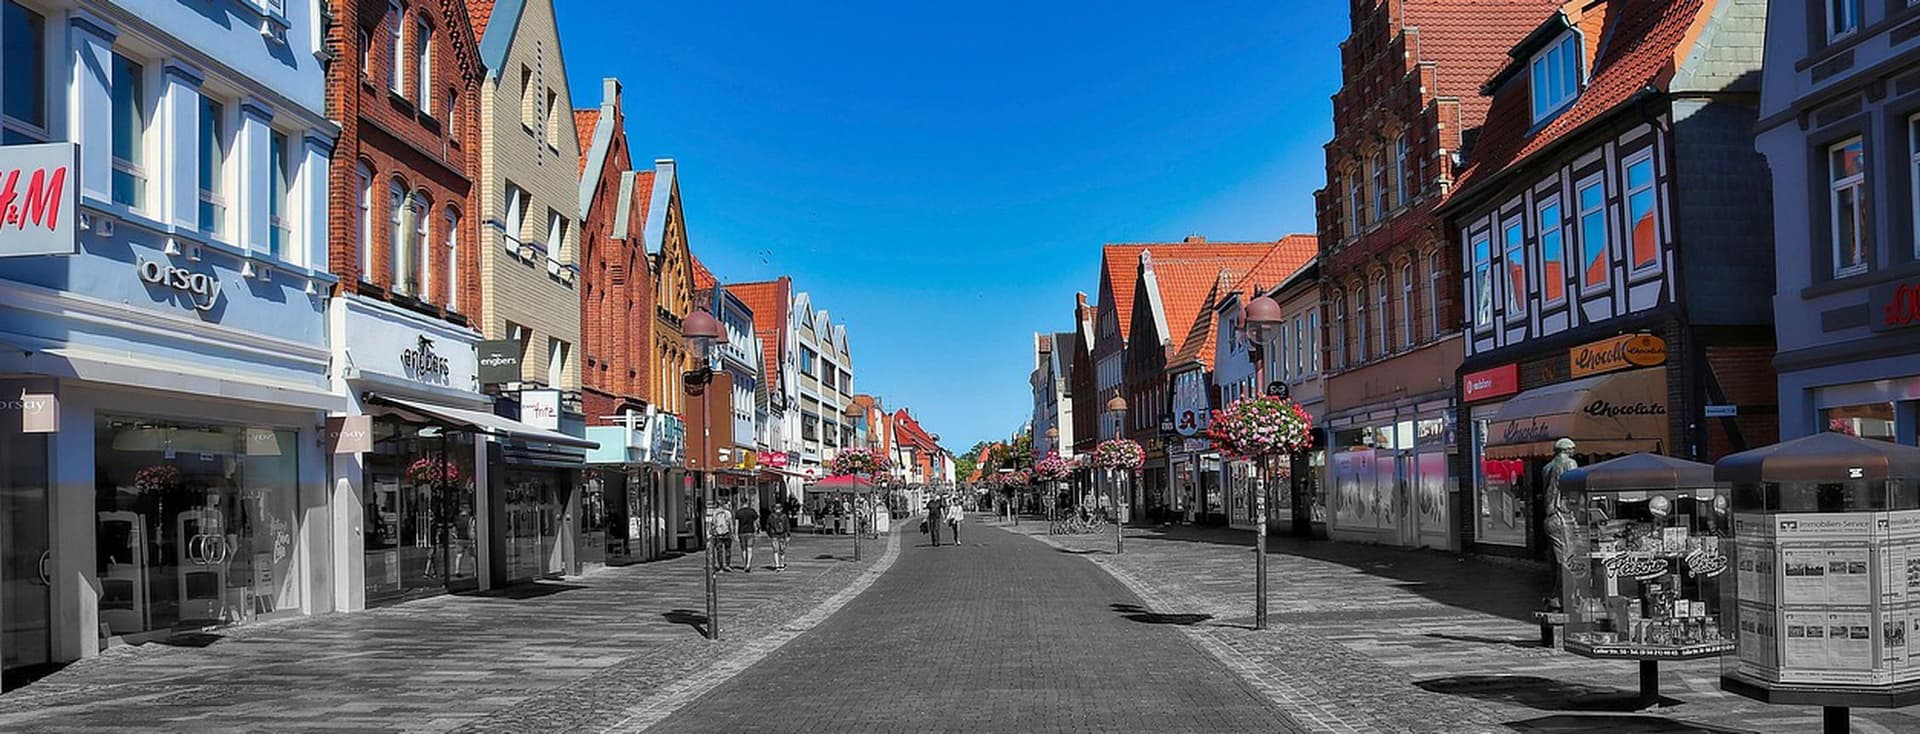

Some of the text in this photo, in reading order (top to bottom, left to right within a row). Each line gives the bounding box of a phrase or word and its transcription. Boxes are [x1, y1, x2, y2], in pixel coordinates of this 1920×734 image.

[140, 260, 221, 310] orsay
[403, 348, 450, 376] engbers
[480, 358, 517, 367] engbers
[1575, 341, 1621, 369] Chocol
[1584, 399, 1666, 417] Chocolata
